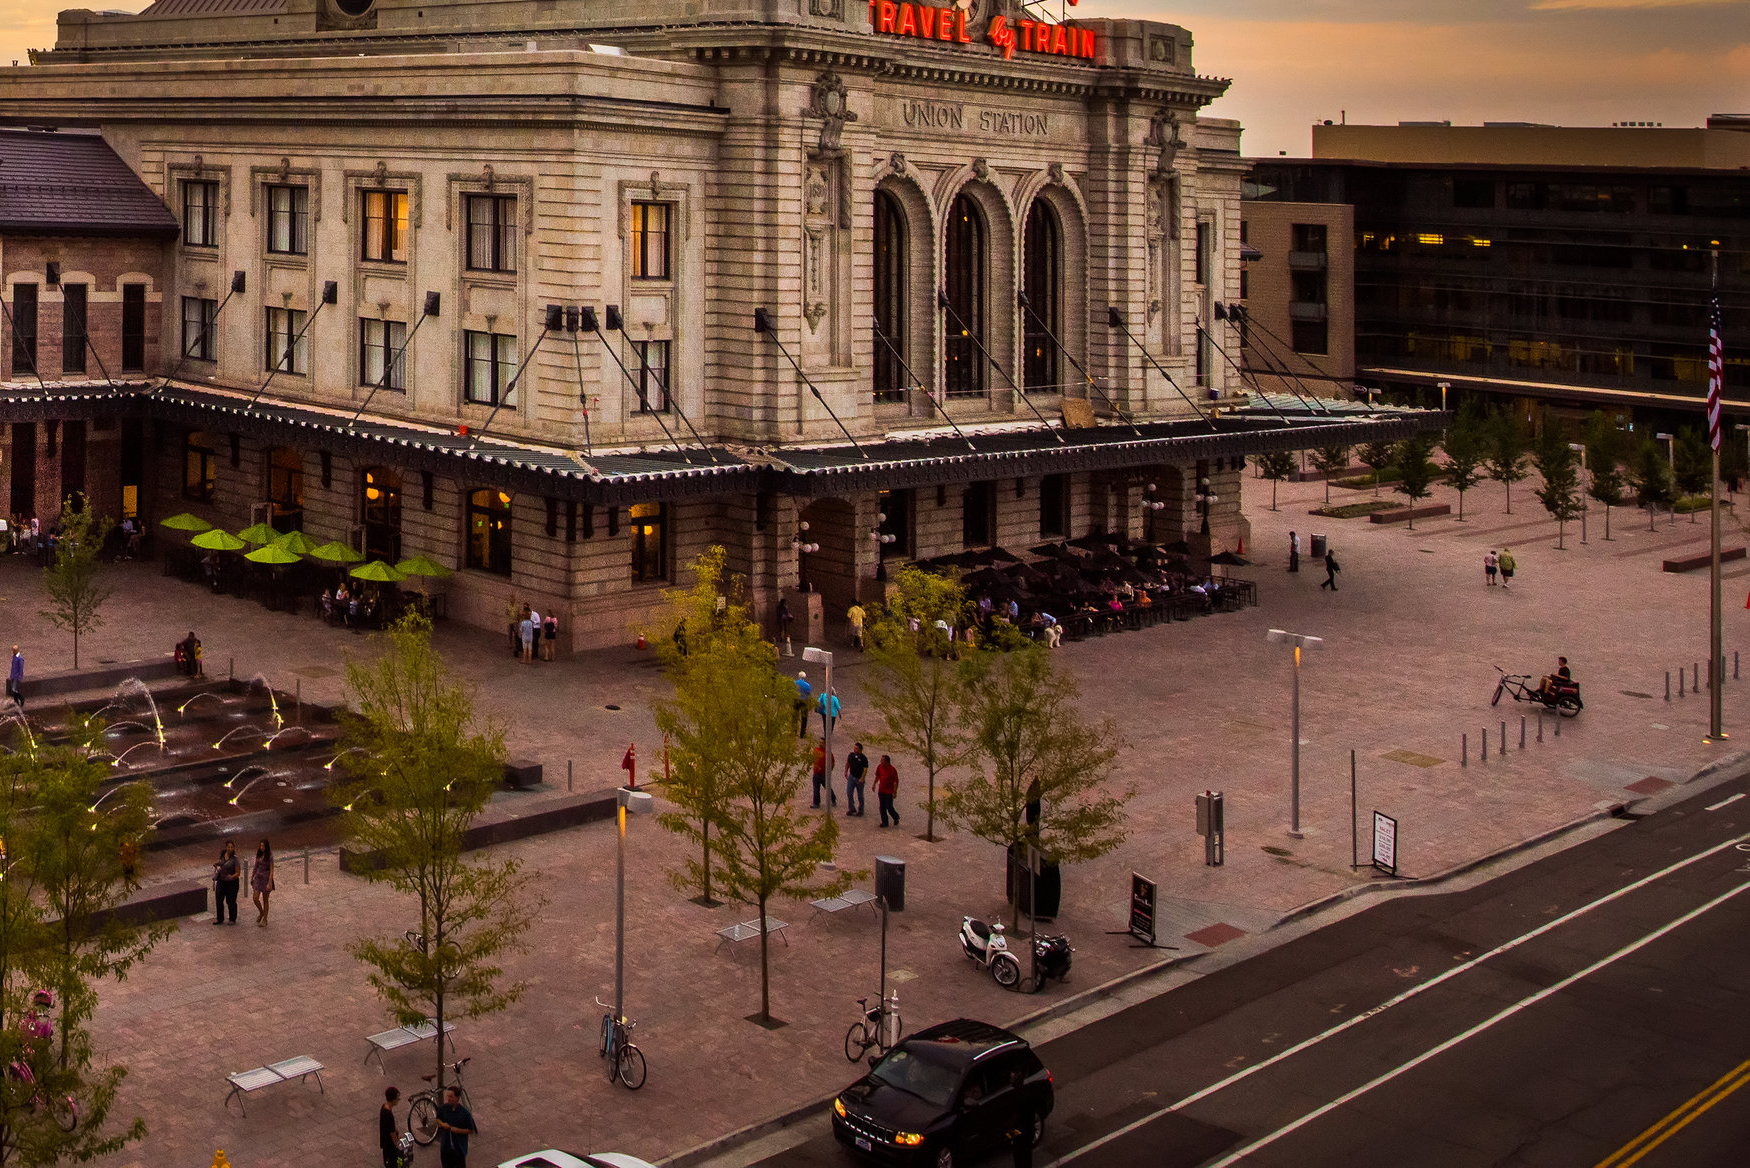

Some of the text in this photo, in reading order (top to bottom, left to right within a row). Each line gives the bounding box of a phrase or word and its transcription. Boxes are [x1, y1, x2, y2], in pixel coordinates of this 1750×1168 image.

[988, 15, 1016, 61] by
[1017, 19, 1095, 59] TRAIN
[903, 103, 1048, 135] UNION STATION
